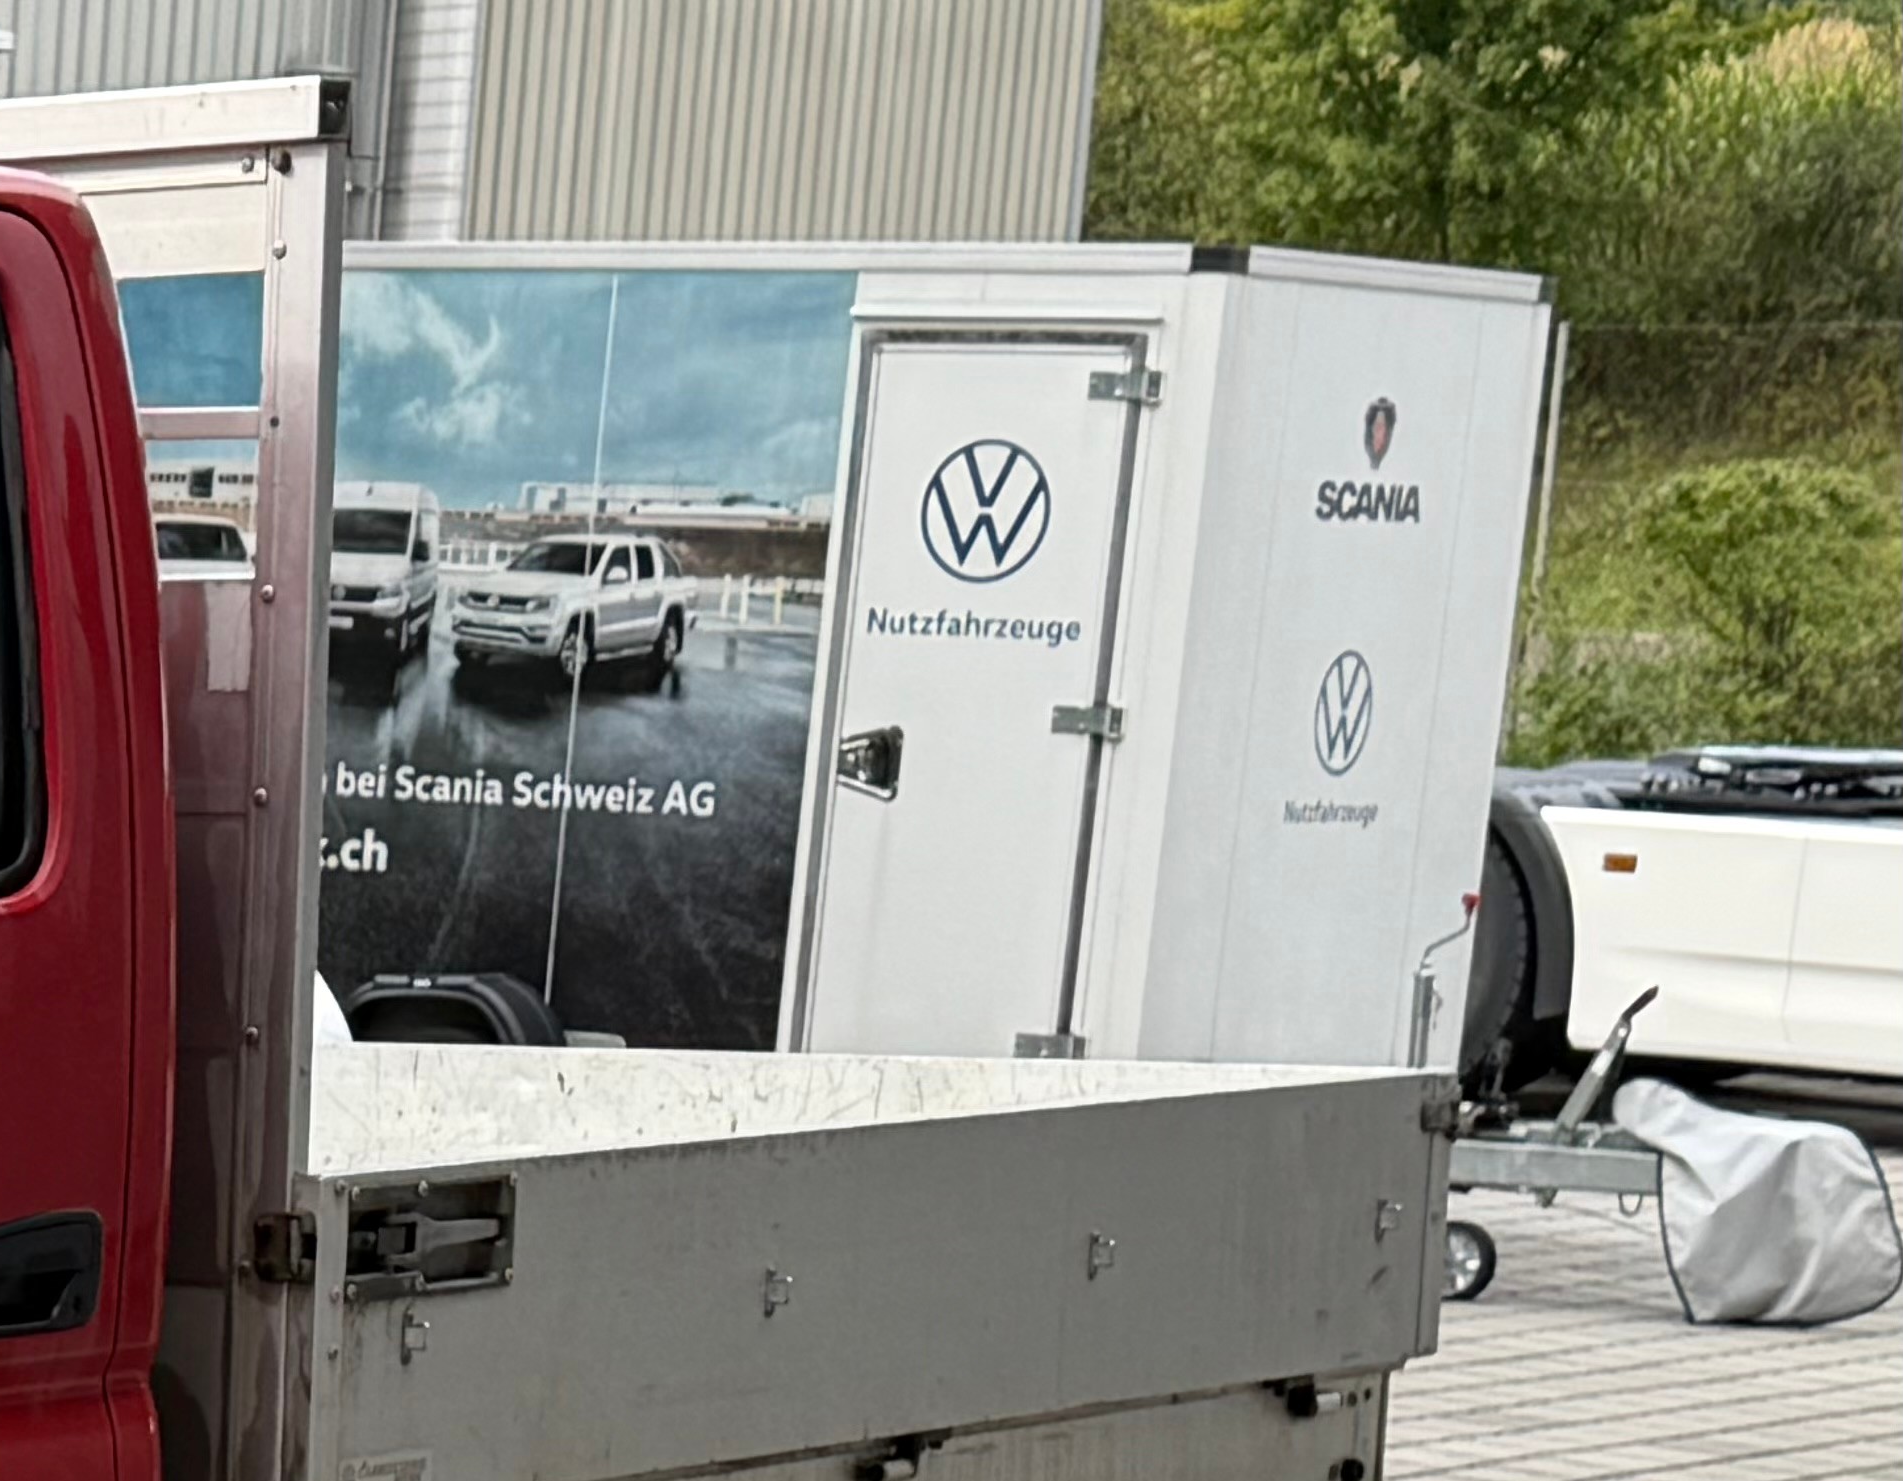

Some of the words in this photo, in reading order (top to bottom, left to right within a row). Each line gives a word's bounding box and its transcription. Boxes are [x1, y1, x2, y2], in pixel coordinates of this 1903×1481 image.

[921, 439, 1051, 584] VW
[1315, 480, 1421, 524] SCANIA
[866, 607, 1082, 649] Nutzfahrzeuge
[336, 760, 387, 799] bei
[394, 764, 504, 807] Scania
[511, 771, 655, 814] Schweiz
[661, 780, 717, 817] AG
[1282, 800, 1380, 830] Nutzfahrzeuge
